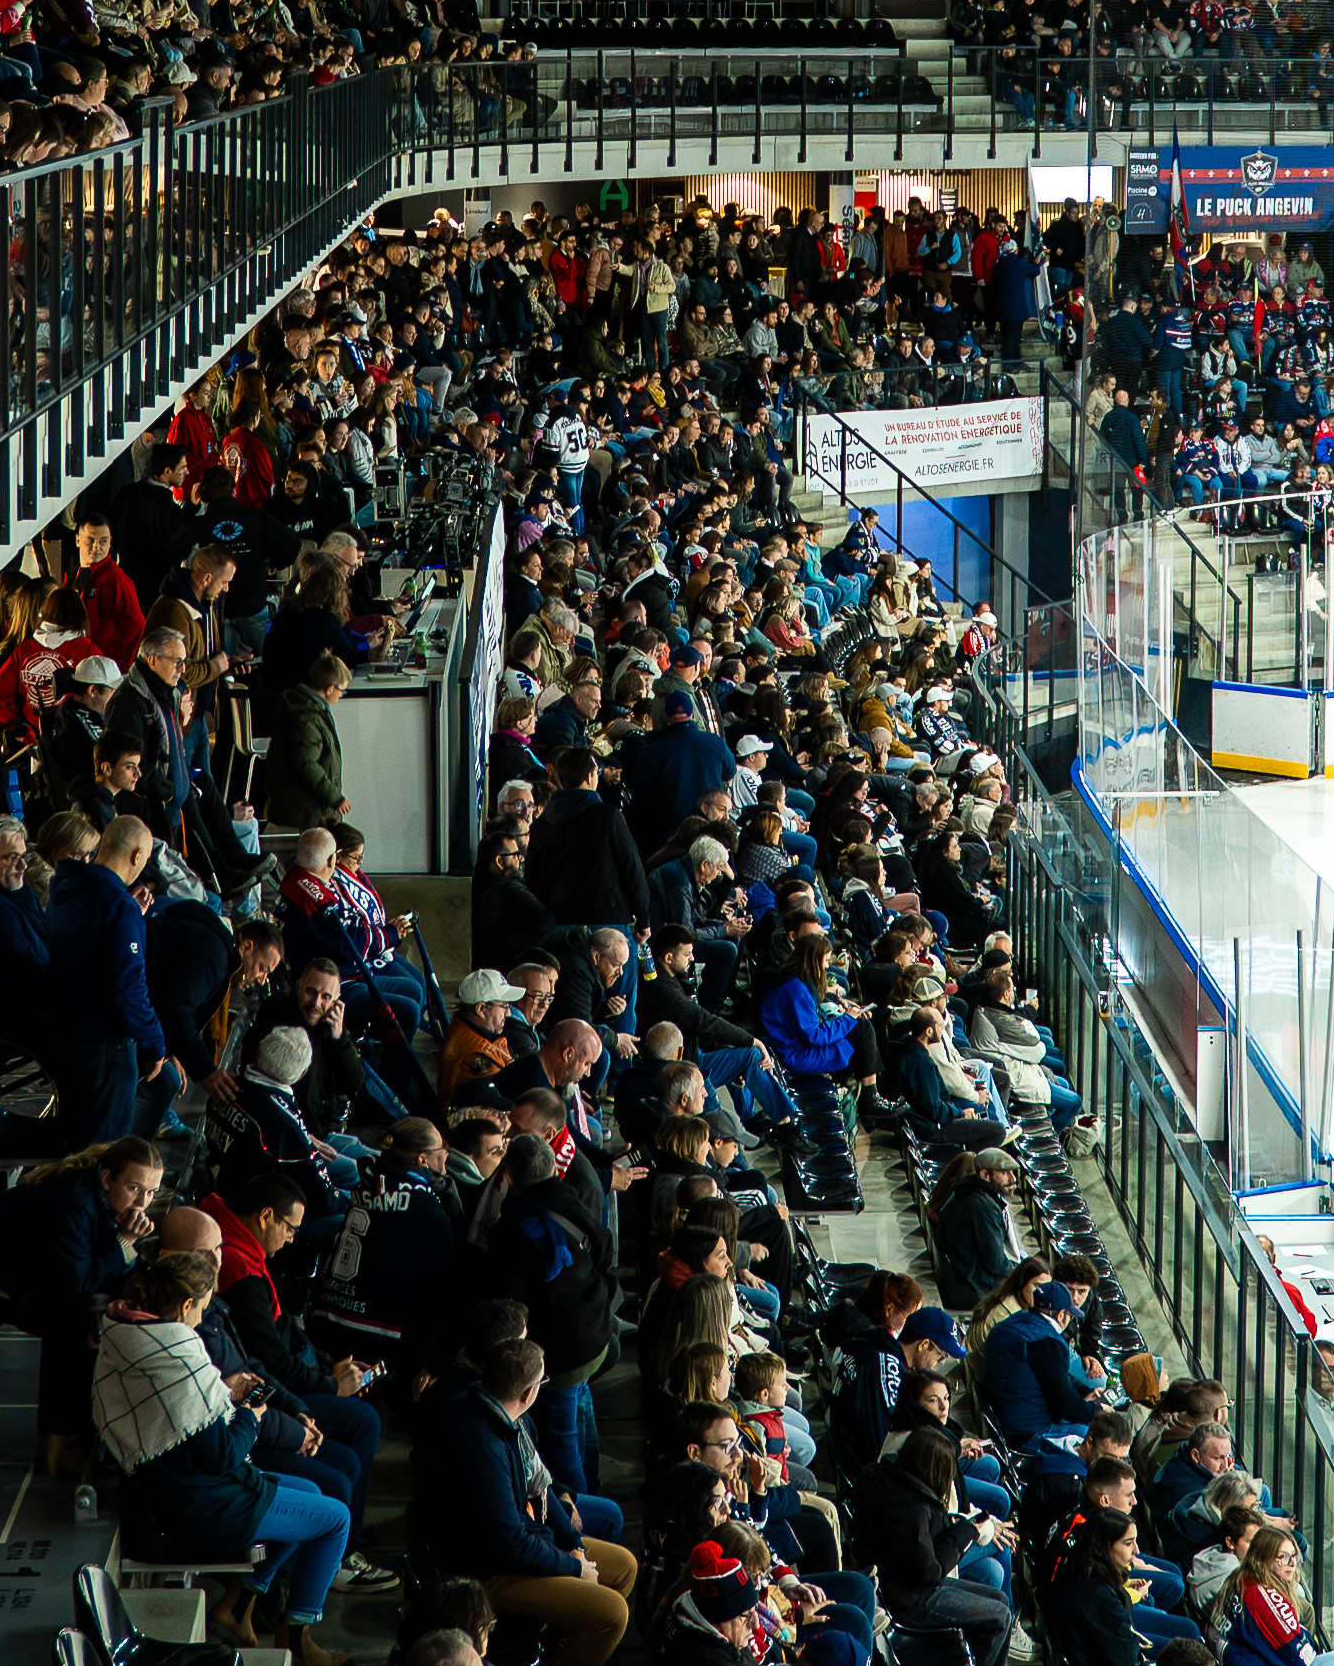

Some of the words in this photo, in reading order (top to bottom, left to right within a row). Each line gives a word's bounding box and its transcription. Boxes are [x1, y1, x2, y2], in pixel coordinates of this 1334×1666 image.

[1197, 199, 1213, 216] LE
[1217, 198, 1252, 216] PUCK
[1256, 197, 1314, 216] ANGEVIN
[884, 422, 896, 432] UN
[897, 420, 926, 432] BUREAU
[963, 416, 975, 426] AU
[977, 412, 1009, 425] SERVICE
[1010, 411, 1022, 420] DE
[885, 434, 898, 445] LA
[822, 450, 877, 473] ÉNRGIE
